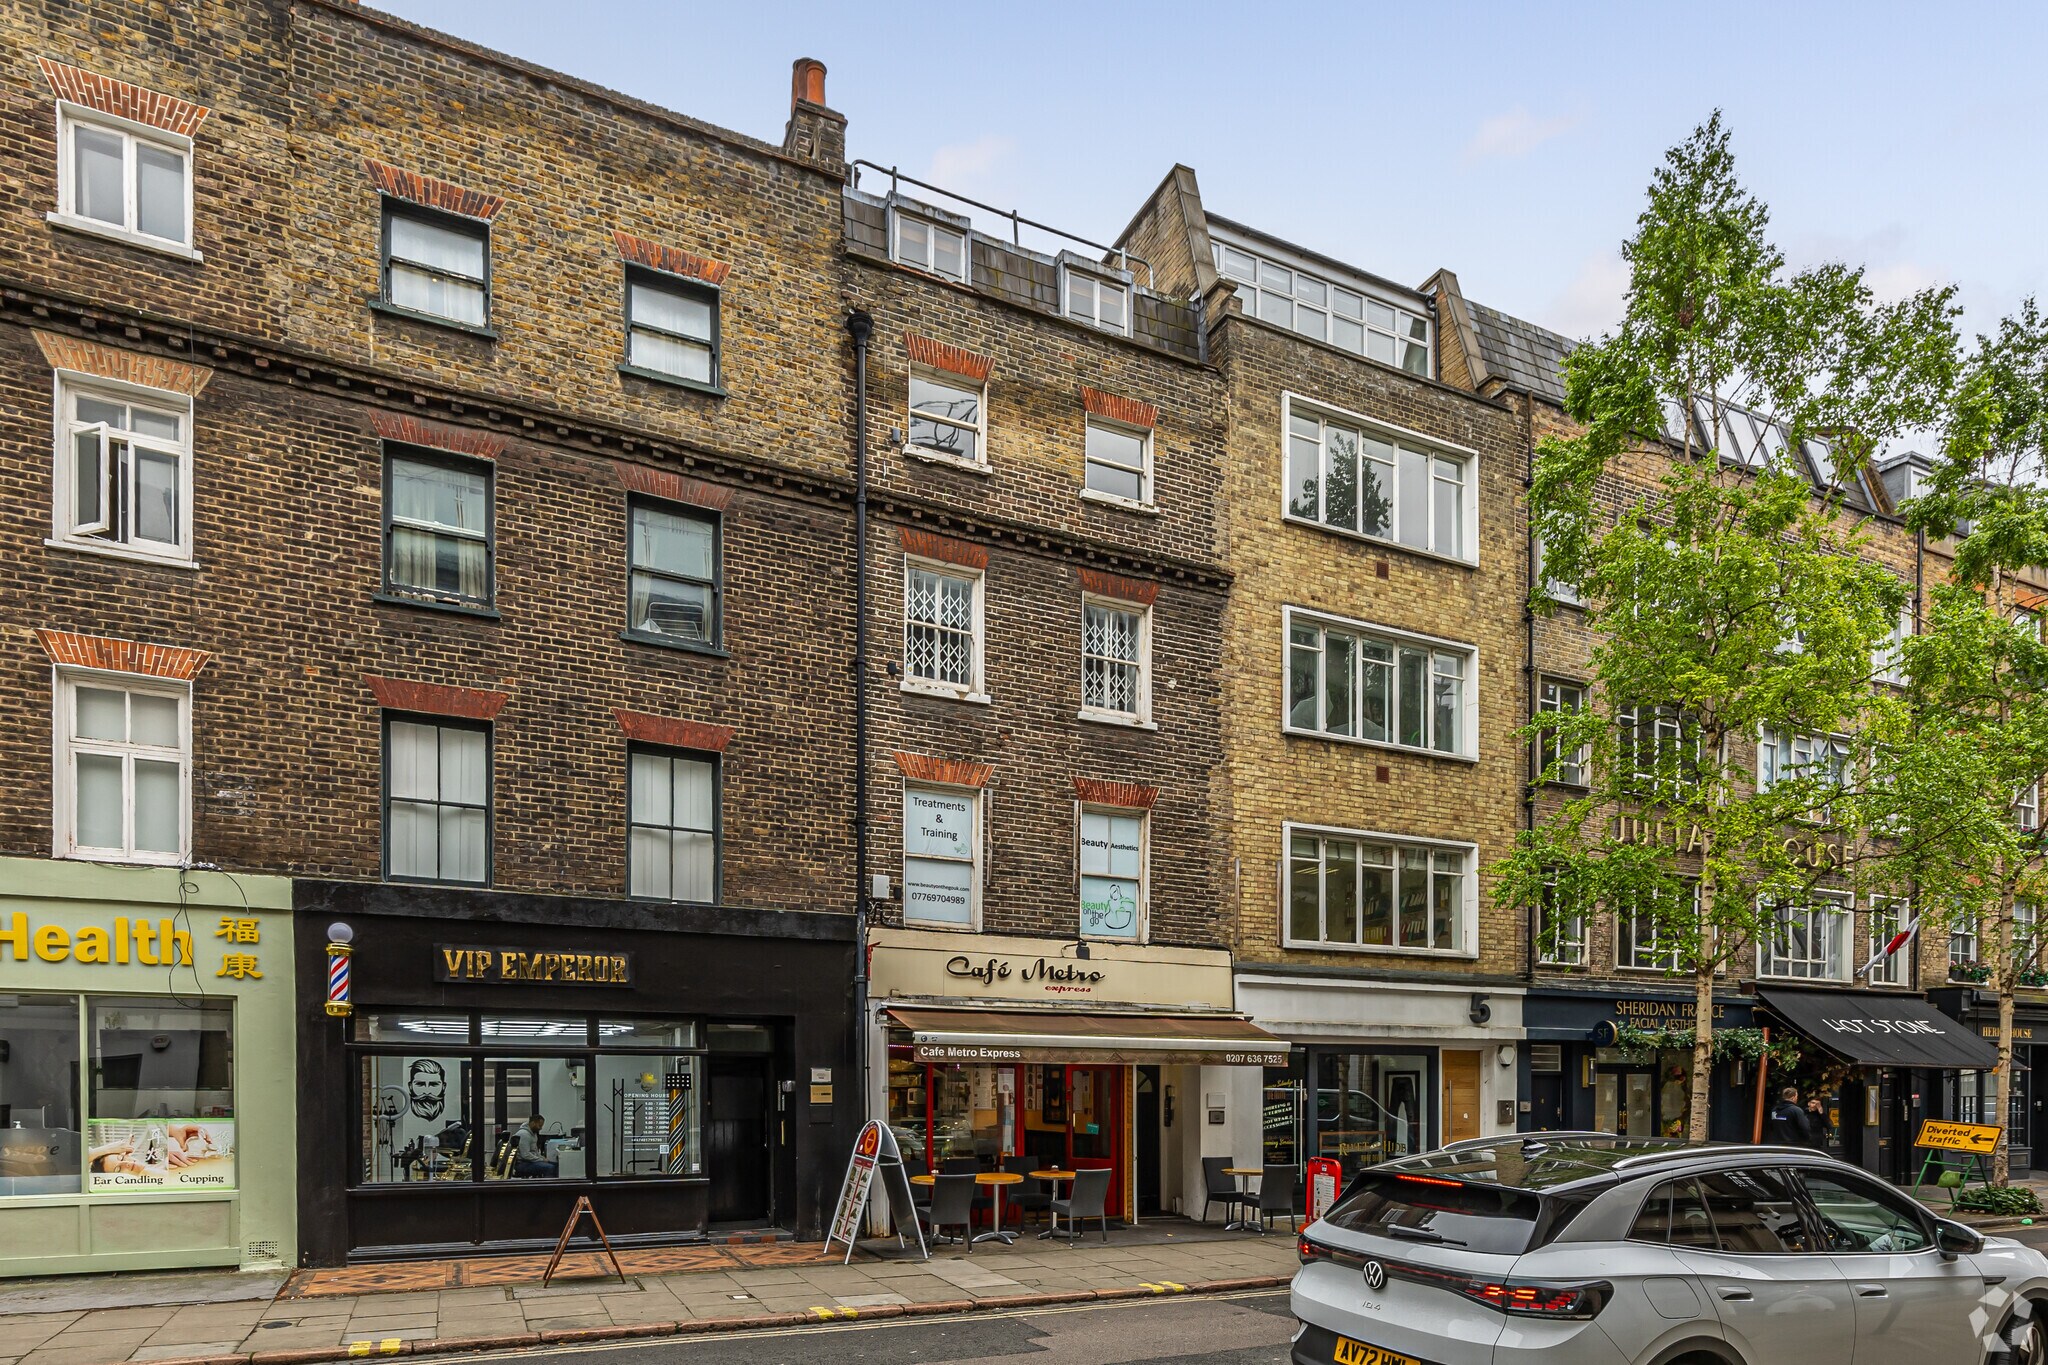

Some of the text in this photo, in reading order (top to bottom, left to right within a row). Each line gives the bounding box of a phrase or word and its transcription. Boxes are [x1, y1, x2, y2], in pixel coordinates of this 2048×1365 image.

[913, 797, 966, 812] Treatments
[935, 814, 943, 823] &
[921, 827, 958, 841] Training
[1081, 838, 1139, 851] Beauty Aesthetics
[911, 892, 965, 905] 07769704989
[1081, 900, 1109, 913] Beauty
[1091, 909, 1104, 919] the
[1090, 917, 1100, 927] go
[0, 911, 194, 966] Health
[214, 916, 264, 979] 福康
[443, 950, 627, 983] VIP EMPEROR
[946, 956, 1106, 985] Café Metro
[1045, 985, 1092, 993] express
[1469, 993, 1491, 1023] 5
[1616, 1001, 1725, 1018] SHERIDAN FRCE
[1630, 1018, 1697, 1031] FACIAL AESTHE
[1822, 1019, 1945, 1034] HOT STONE
[920, 1047, 1021, 1060] Cafe Metro Express
[1226, 1054, 1283, 1063] 0207 636 7525
[1926, 1126, 1971, 1137] Diverted
[1928, 1135, 1961, 1145] traffic
[93, 1175, 163, 1185] Ear Candling
[179, 1174, 224, 1185] Cupping
[1340, 1341, 1379, 1365] AV72
